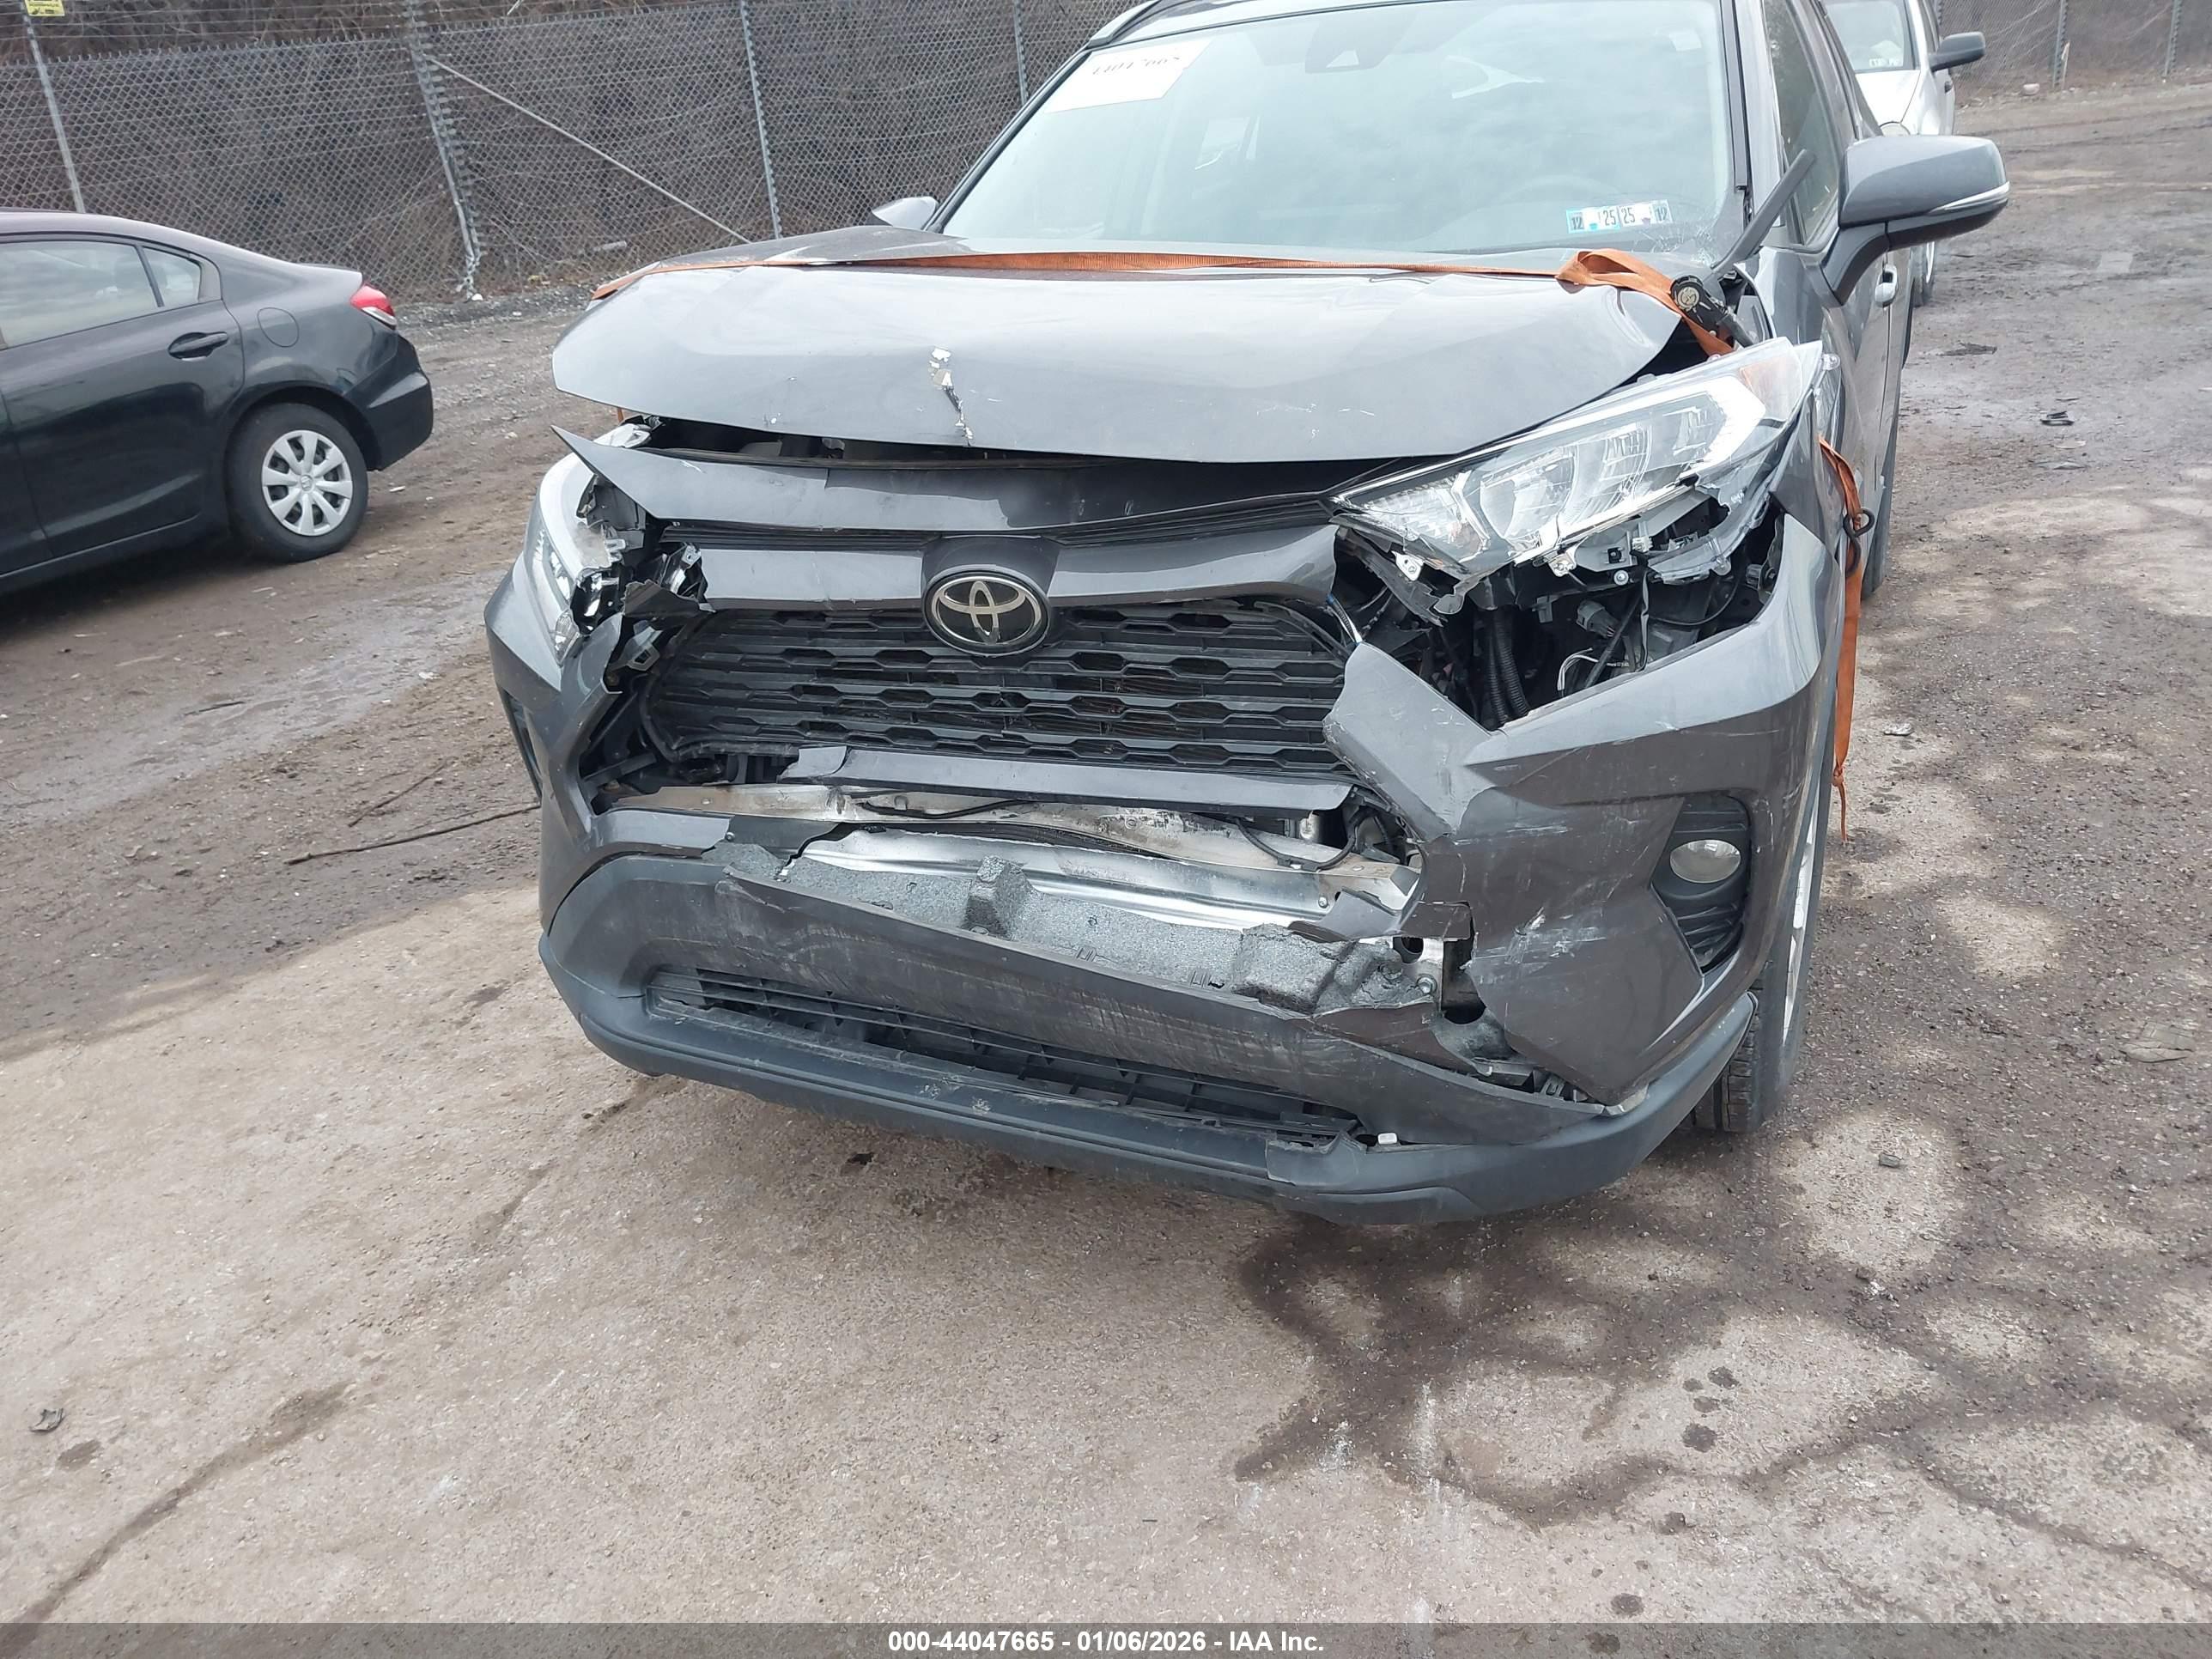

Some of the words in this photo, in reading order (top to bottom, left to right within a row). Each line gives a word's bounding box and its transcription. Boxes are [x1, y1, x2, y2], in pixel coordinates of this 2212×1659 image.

[1571, 216, 1584, 230] 12
[1603, 210, 1617, 226] 25
[1621, 207, 1636, 224] 25
